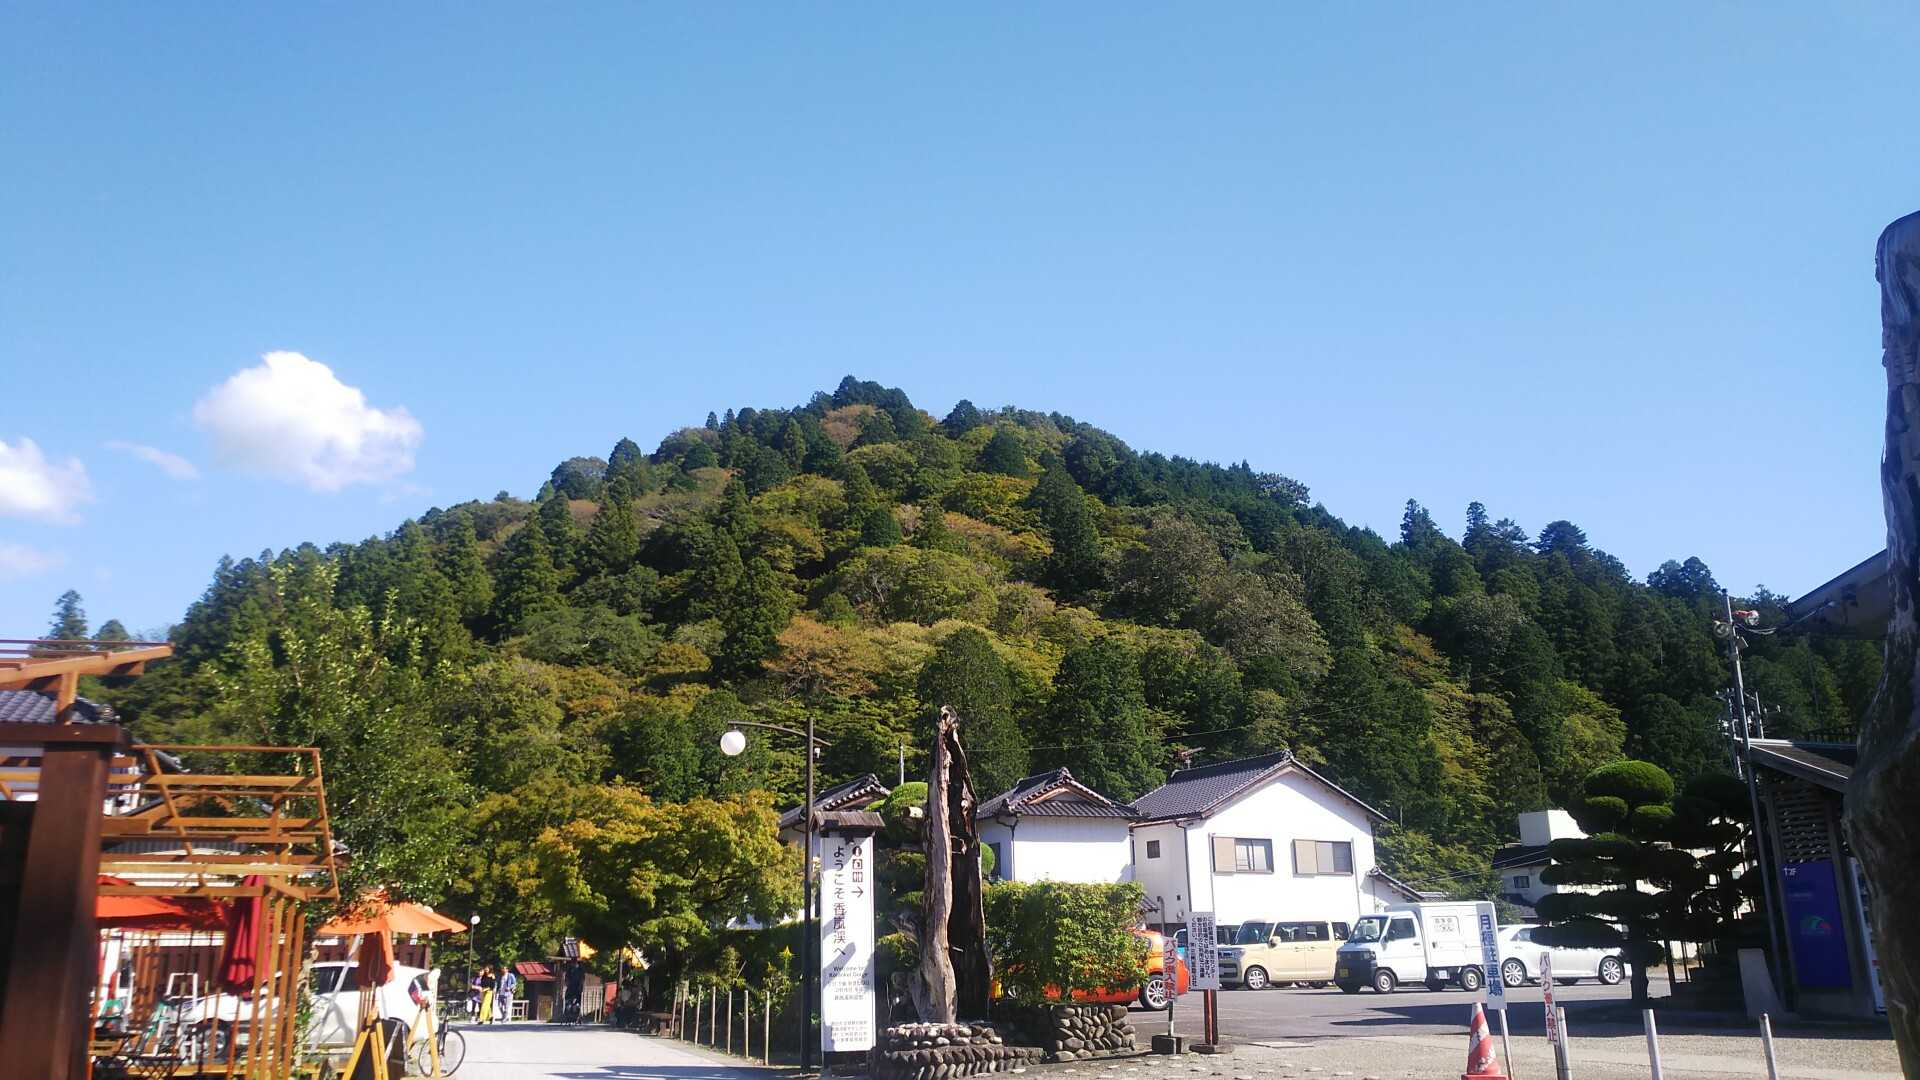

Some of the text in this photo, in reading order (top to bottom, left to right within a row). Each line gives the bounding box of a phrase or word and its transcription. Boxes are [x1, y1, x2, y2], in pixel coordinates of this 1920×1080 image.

[833, 845, 847, 956] ようこそ香嵐渓へ
[1480, 914, 1503, 997] 月極駐車場
